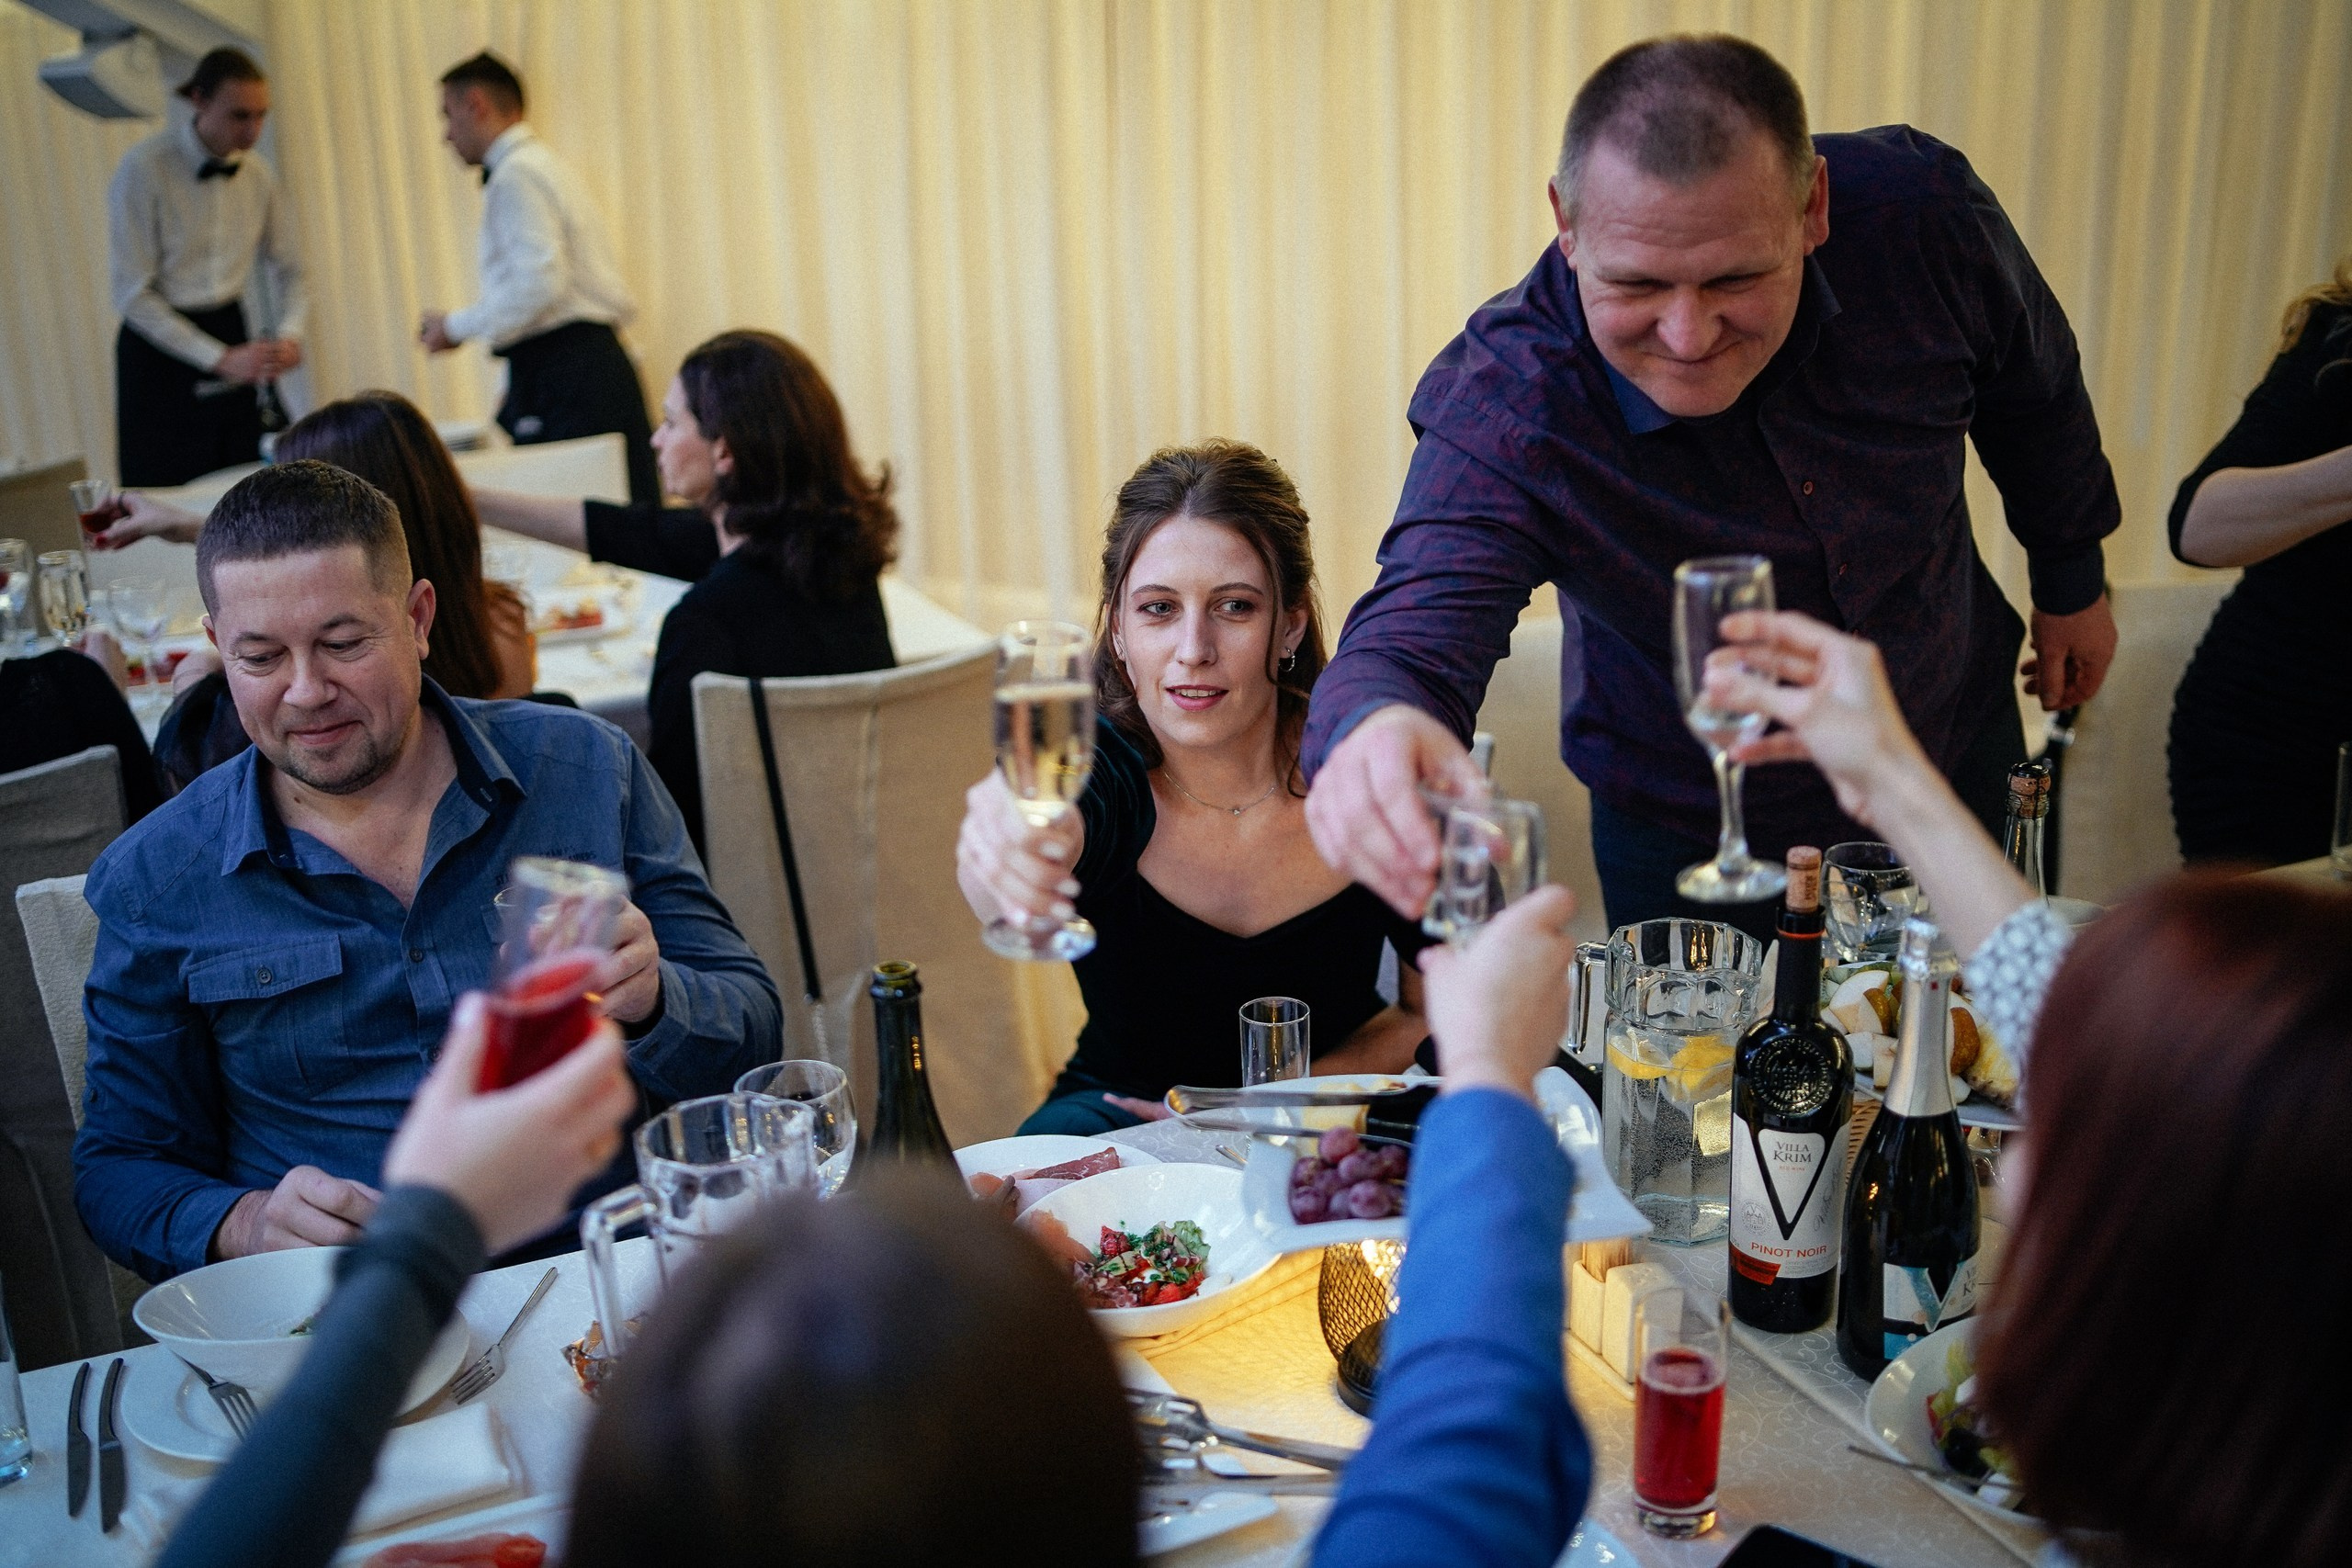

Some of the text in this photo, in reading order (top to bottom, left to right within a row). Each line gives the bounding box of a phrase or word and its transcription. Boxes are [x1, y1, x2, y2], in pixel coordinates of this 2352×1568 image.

[1775, 1141, 1810, 1152] VILLA
[1773, 1150, 1812, 1163] KRIM
[1751, 1242, 1827, 1258] PINOT NOIR
